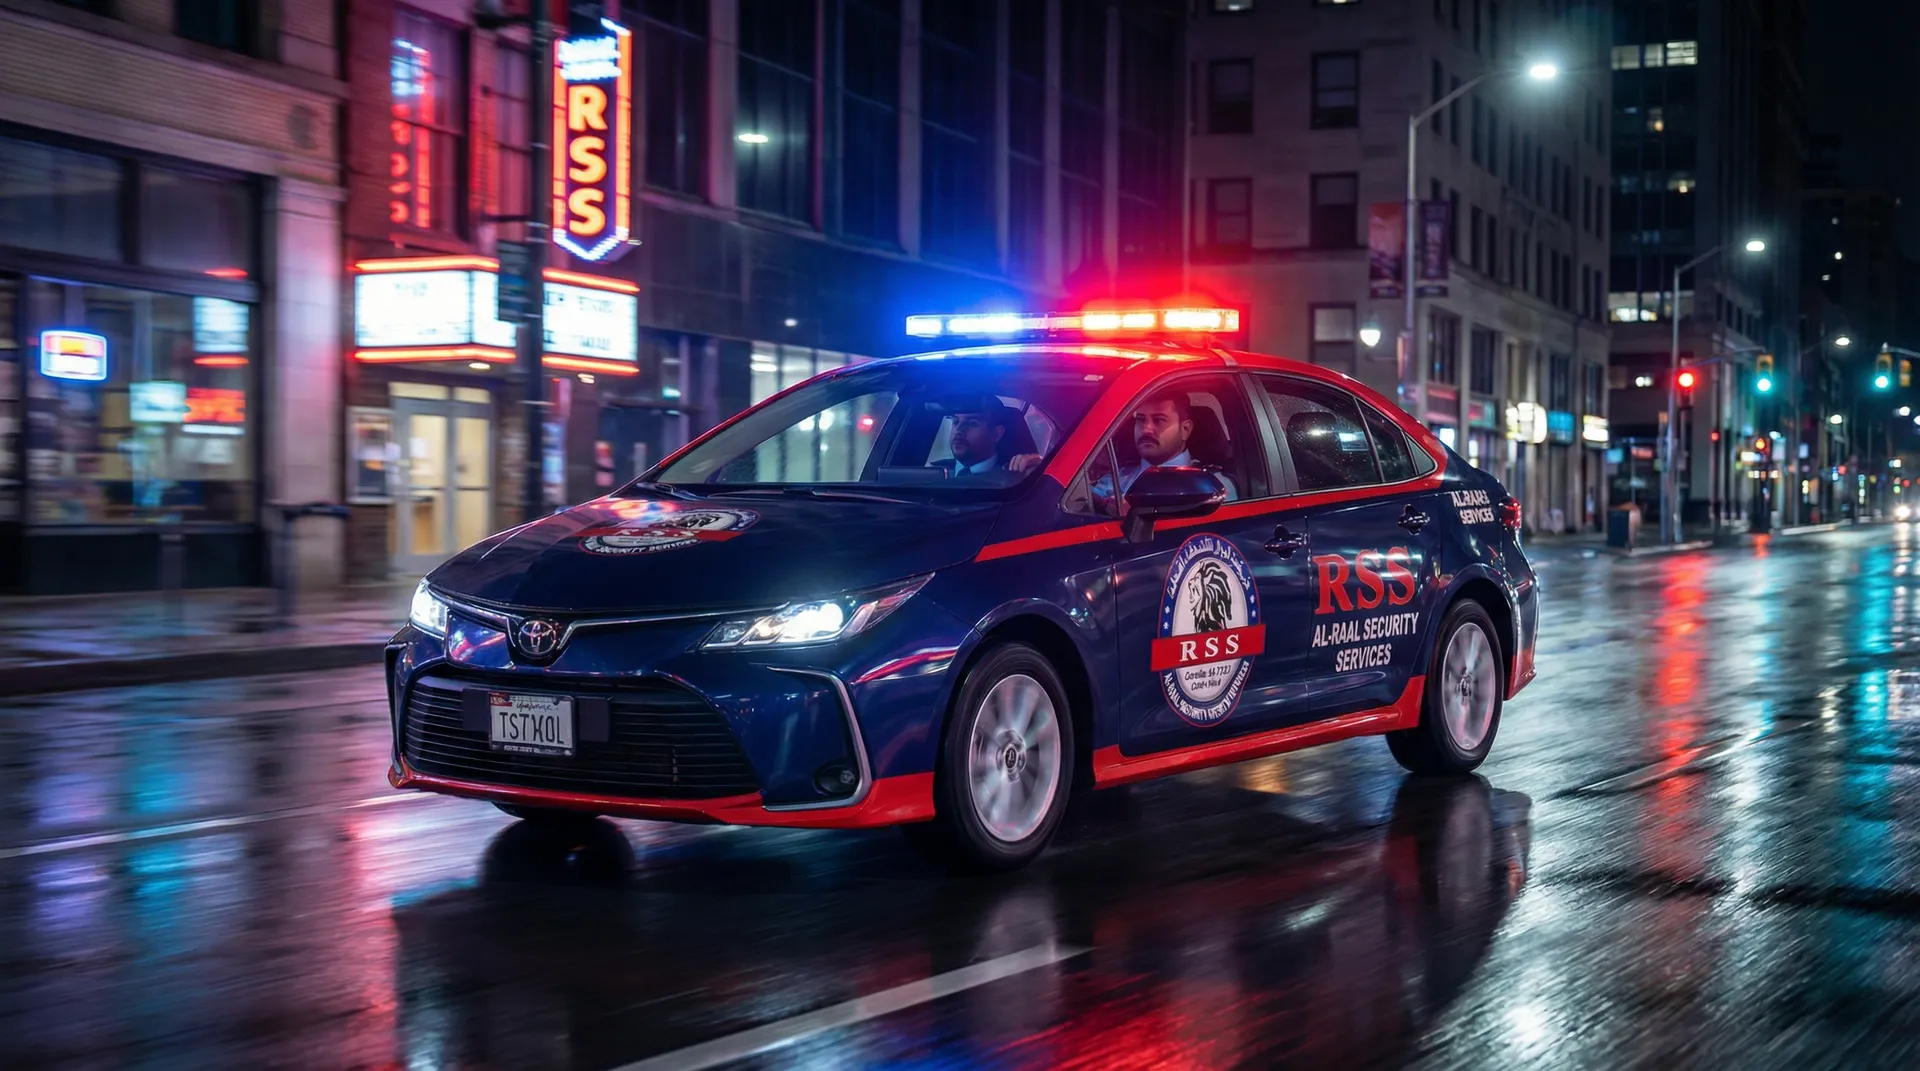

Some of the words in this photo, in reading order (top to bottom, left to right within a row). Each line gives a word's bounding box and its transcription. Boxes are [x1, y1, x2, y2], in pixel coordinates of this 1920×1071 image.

[568, 84, 608, 237] RSS
[1312, 545, 1416, 615] RSS
[1312, 620, 1361, 648] AL-RAAL
[1363, 612, 1420, 641] SECURITY
[1335, 643, 1392, 672] SERVICES
